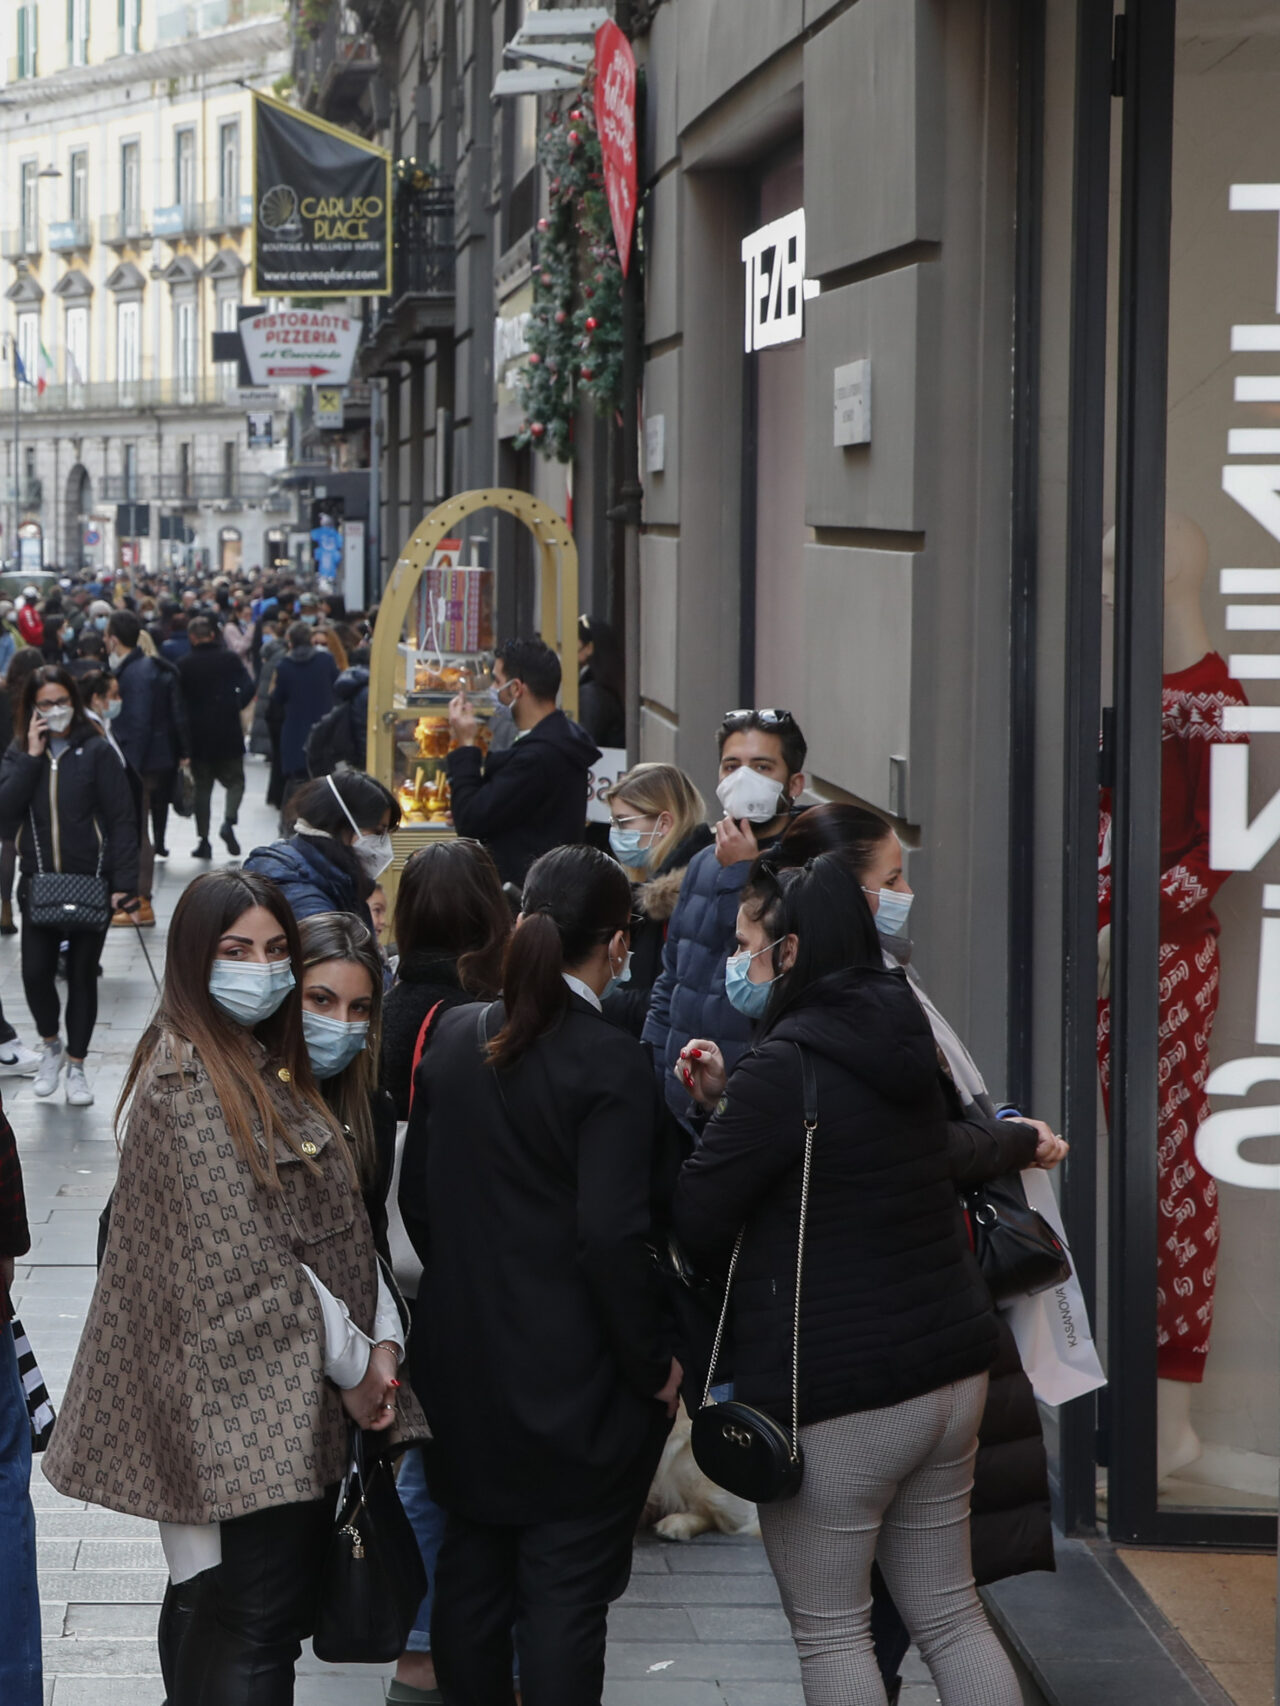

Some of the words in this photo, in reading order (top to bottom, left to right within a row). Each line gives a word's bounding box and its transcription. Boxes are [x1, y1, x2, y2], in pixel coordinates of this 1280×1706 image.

[300, 196, 383, 219] CARUSO
[314, 218, 369, 240] PLACE
[263, 266, 379, 284] www.carusoplace.com
[741, 207, 820, 354] TEZE
[252, 311, 351, 332] RISTORANTE
[265, 330, 337, 344] PIZZERIA
[1055, 1286, 1078, 1349] KASANOVA
